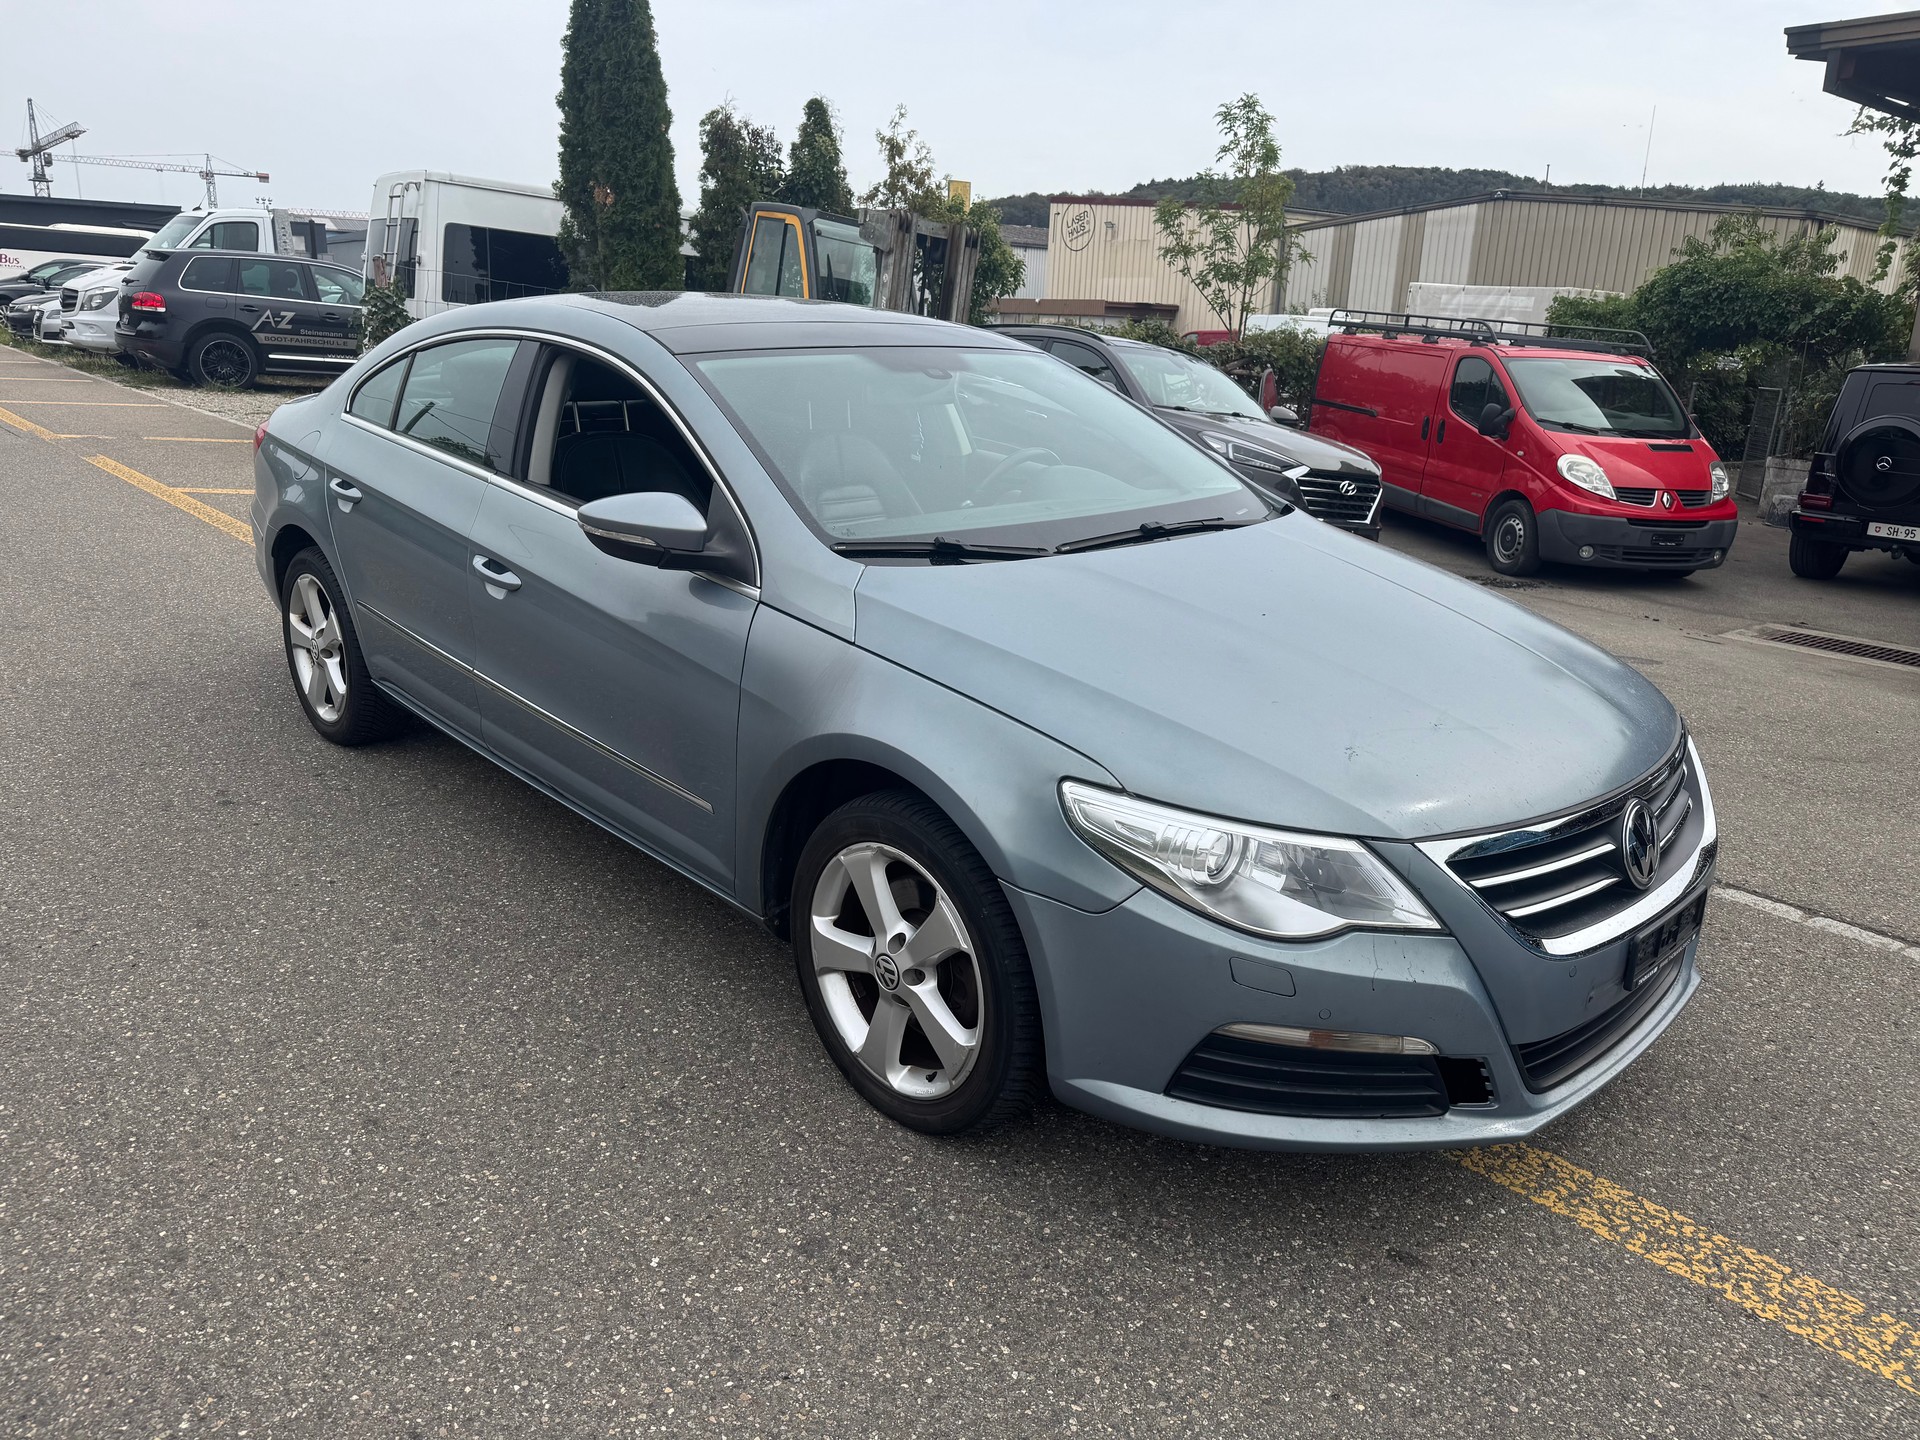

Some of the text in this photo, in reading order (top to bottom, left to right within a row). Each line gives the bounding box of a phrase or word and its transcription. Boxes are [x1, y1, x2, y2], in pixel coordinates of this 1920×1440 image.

[1067, 210, 1088, 228] LASER
[1068, 222, 1086, 238] HAUS
[250, 309, 296, 332] A-Z
[300, 329, 343, 337] Steinemann
